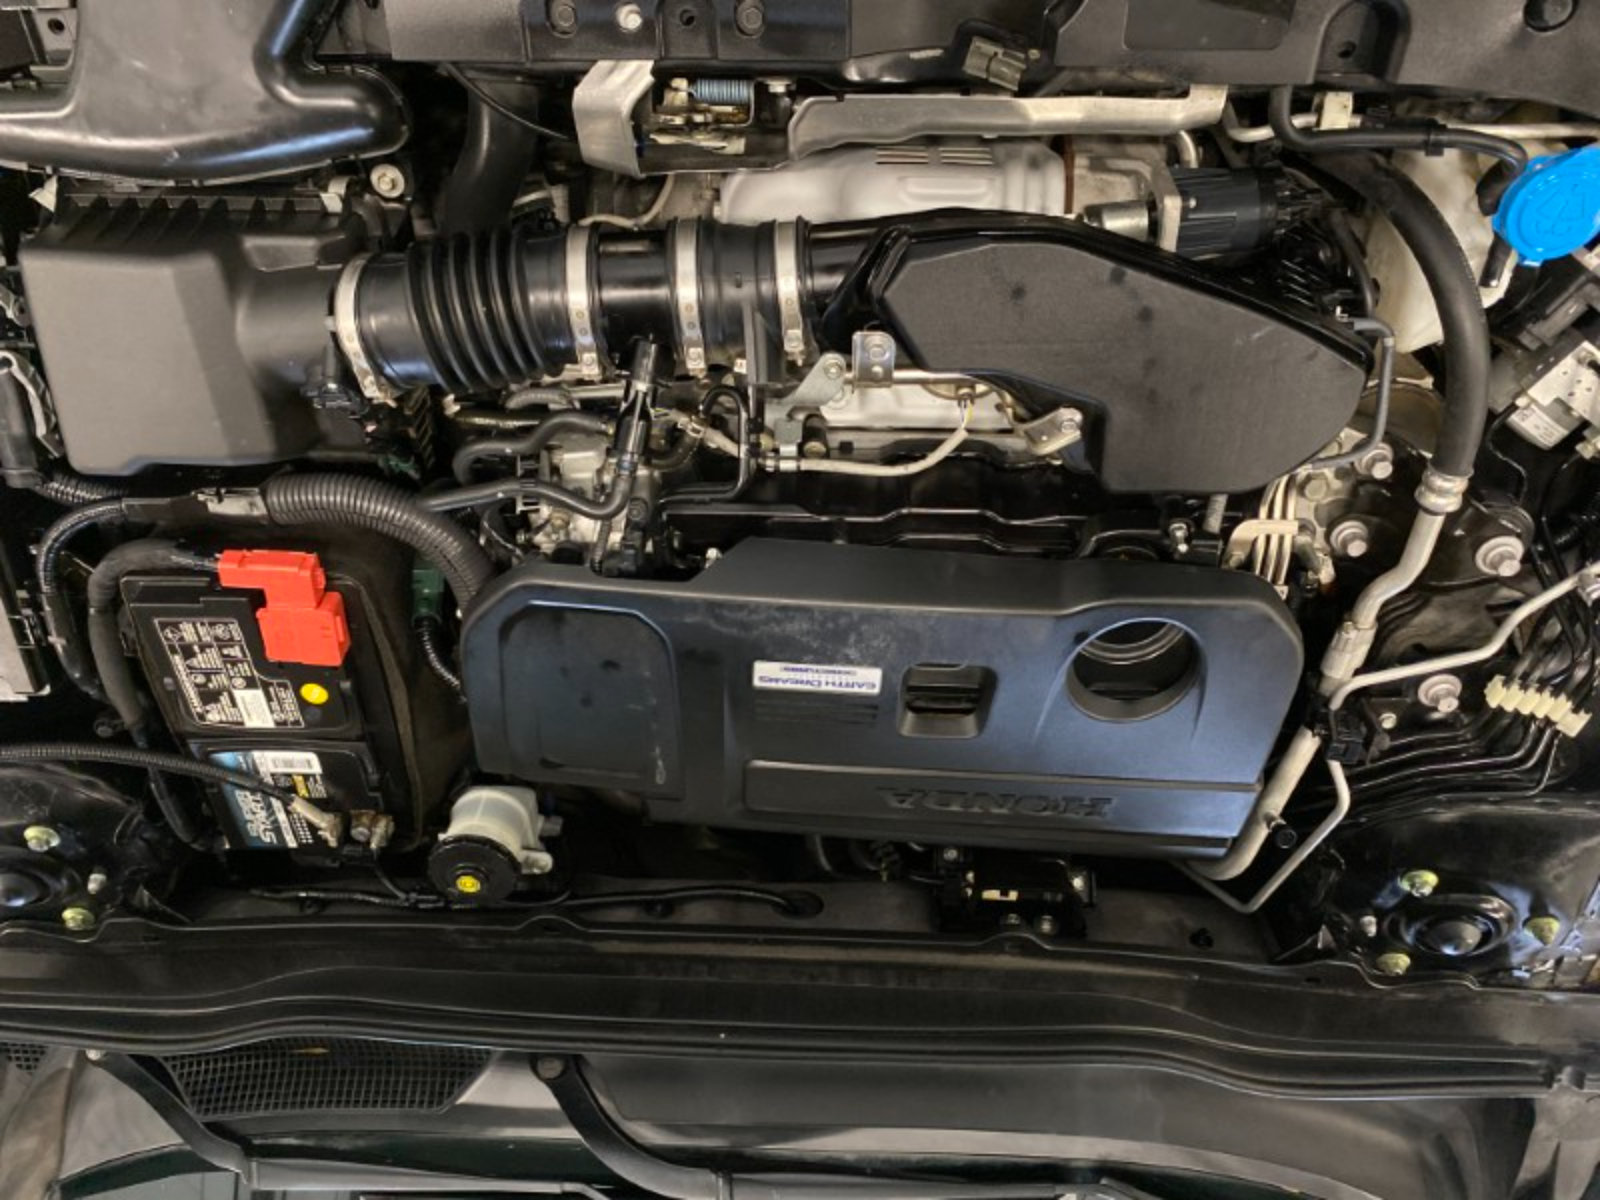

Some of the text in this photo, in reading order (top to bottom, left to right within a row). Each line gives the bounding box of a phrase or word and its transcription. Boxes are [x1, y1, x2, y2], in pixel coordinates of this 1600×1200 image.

[234, 788, 261, 837] SUPER
[249, 791, 278, 845] START
[876, 786, 1114, 817] HONDA
